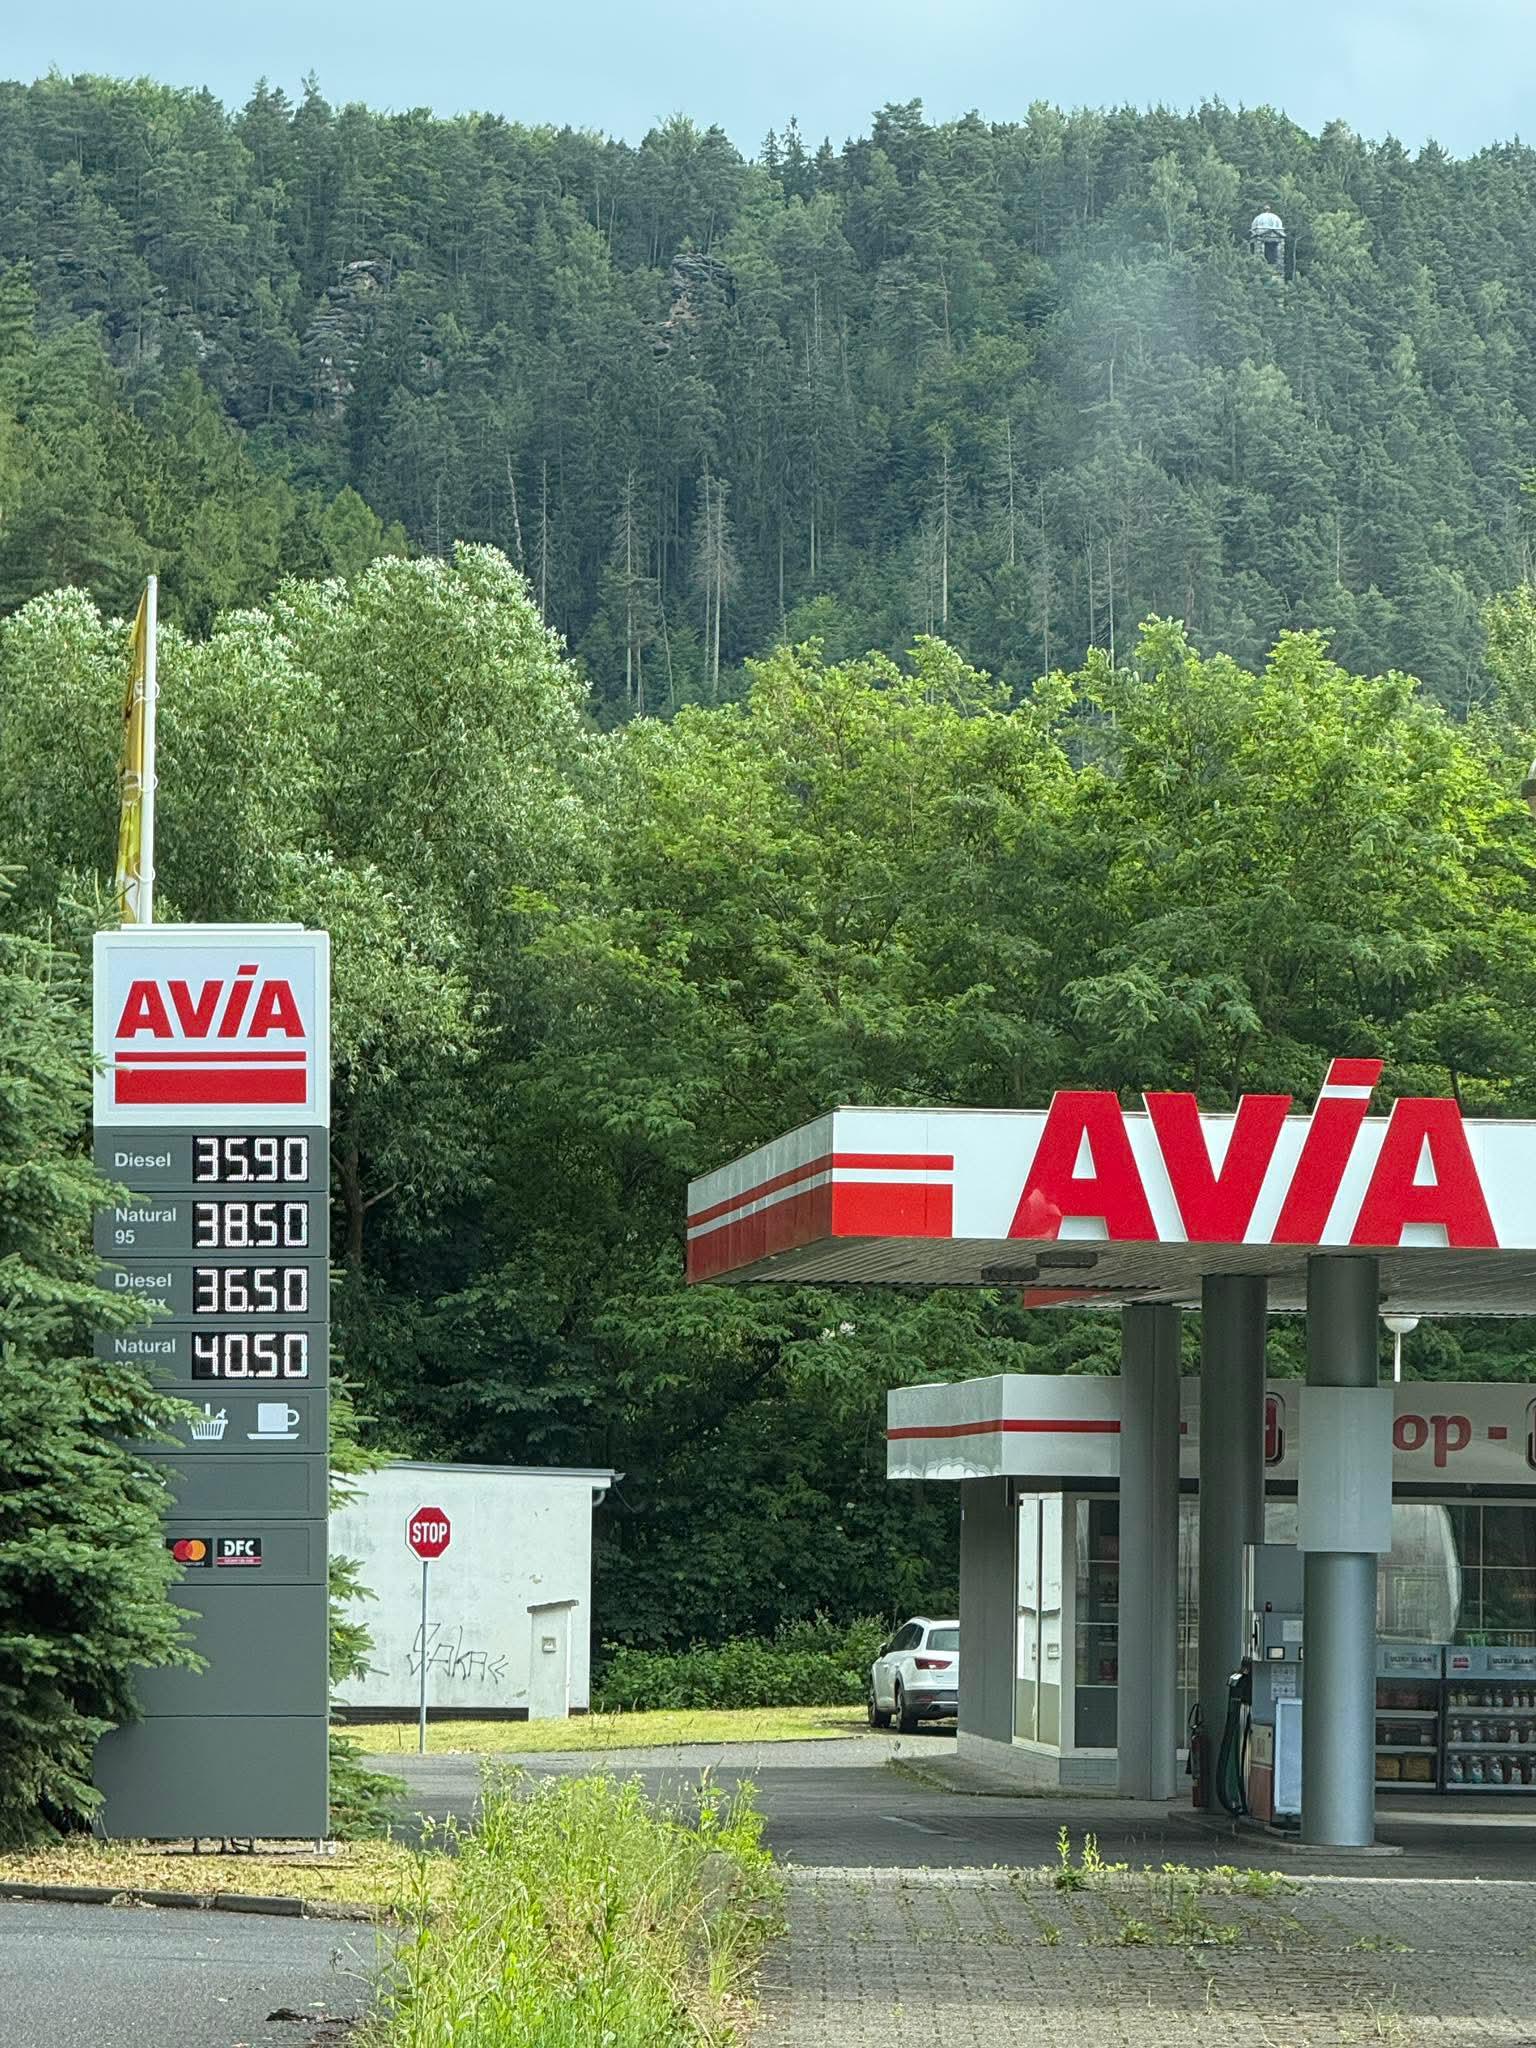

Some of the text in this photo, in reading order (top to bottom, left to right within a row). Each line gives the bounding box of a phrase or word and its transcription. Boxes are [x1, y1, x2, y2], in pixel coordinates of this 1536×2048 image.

[115, 1138, 307, 1182] Diesel 35.90
[115, 1204, 307, 1247] Natural 38.50
[115, 1230, 135, 1244] 95
[115, 1269, 307, 1312] Diesel 36.50
[115, 1335, 307, 1377] Natural 40.50
[224, 1540, 254, 1556] DFC
[412, 1522, 448, 1544] STOP
